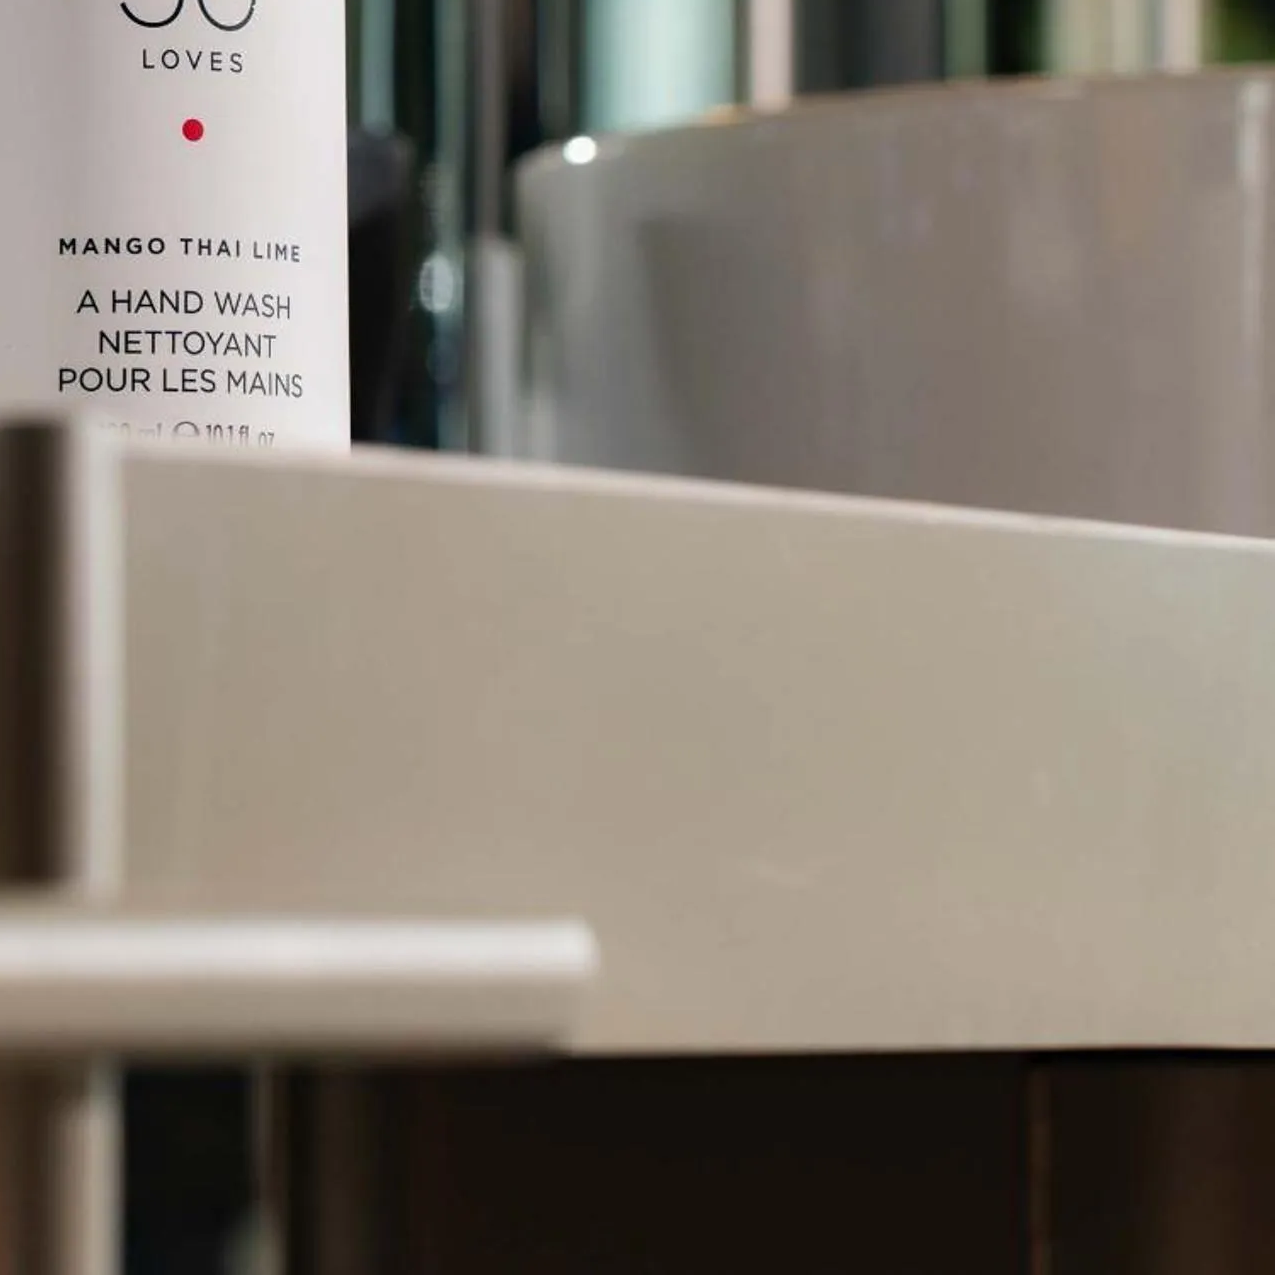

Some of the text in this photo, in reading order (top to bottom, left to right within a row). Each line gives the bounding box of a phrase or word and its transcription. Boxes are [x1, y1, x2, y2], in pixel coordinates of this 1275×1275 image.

[142, 48, 245, 73] LOVES
[59, 237, 300, 263] MANGO THAI LIME
[75, 290, 291, 319] A HAND WASH
[99, 330, 277, 359] NETTOYANT
[58, 368, 303, 398] POUR LES MAINS
